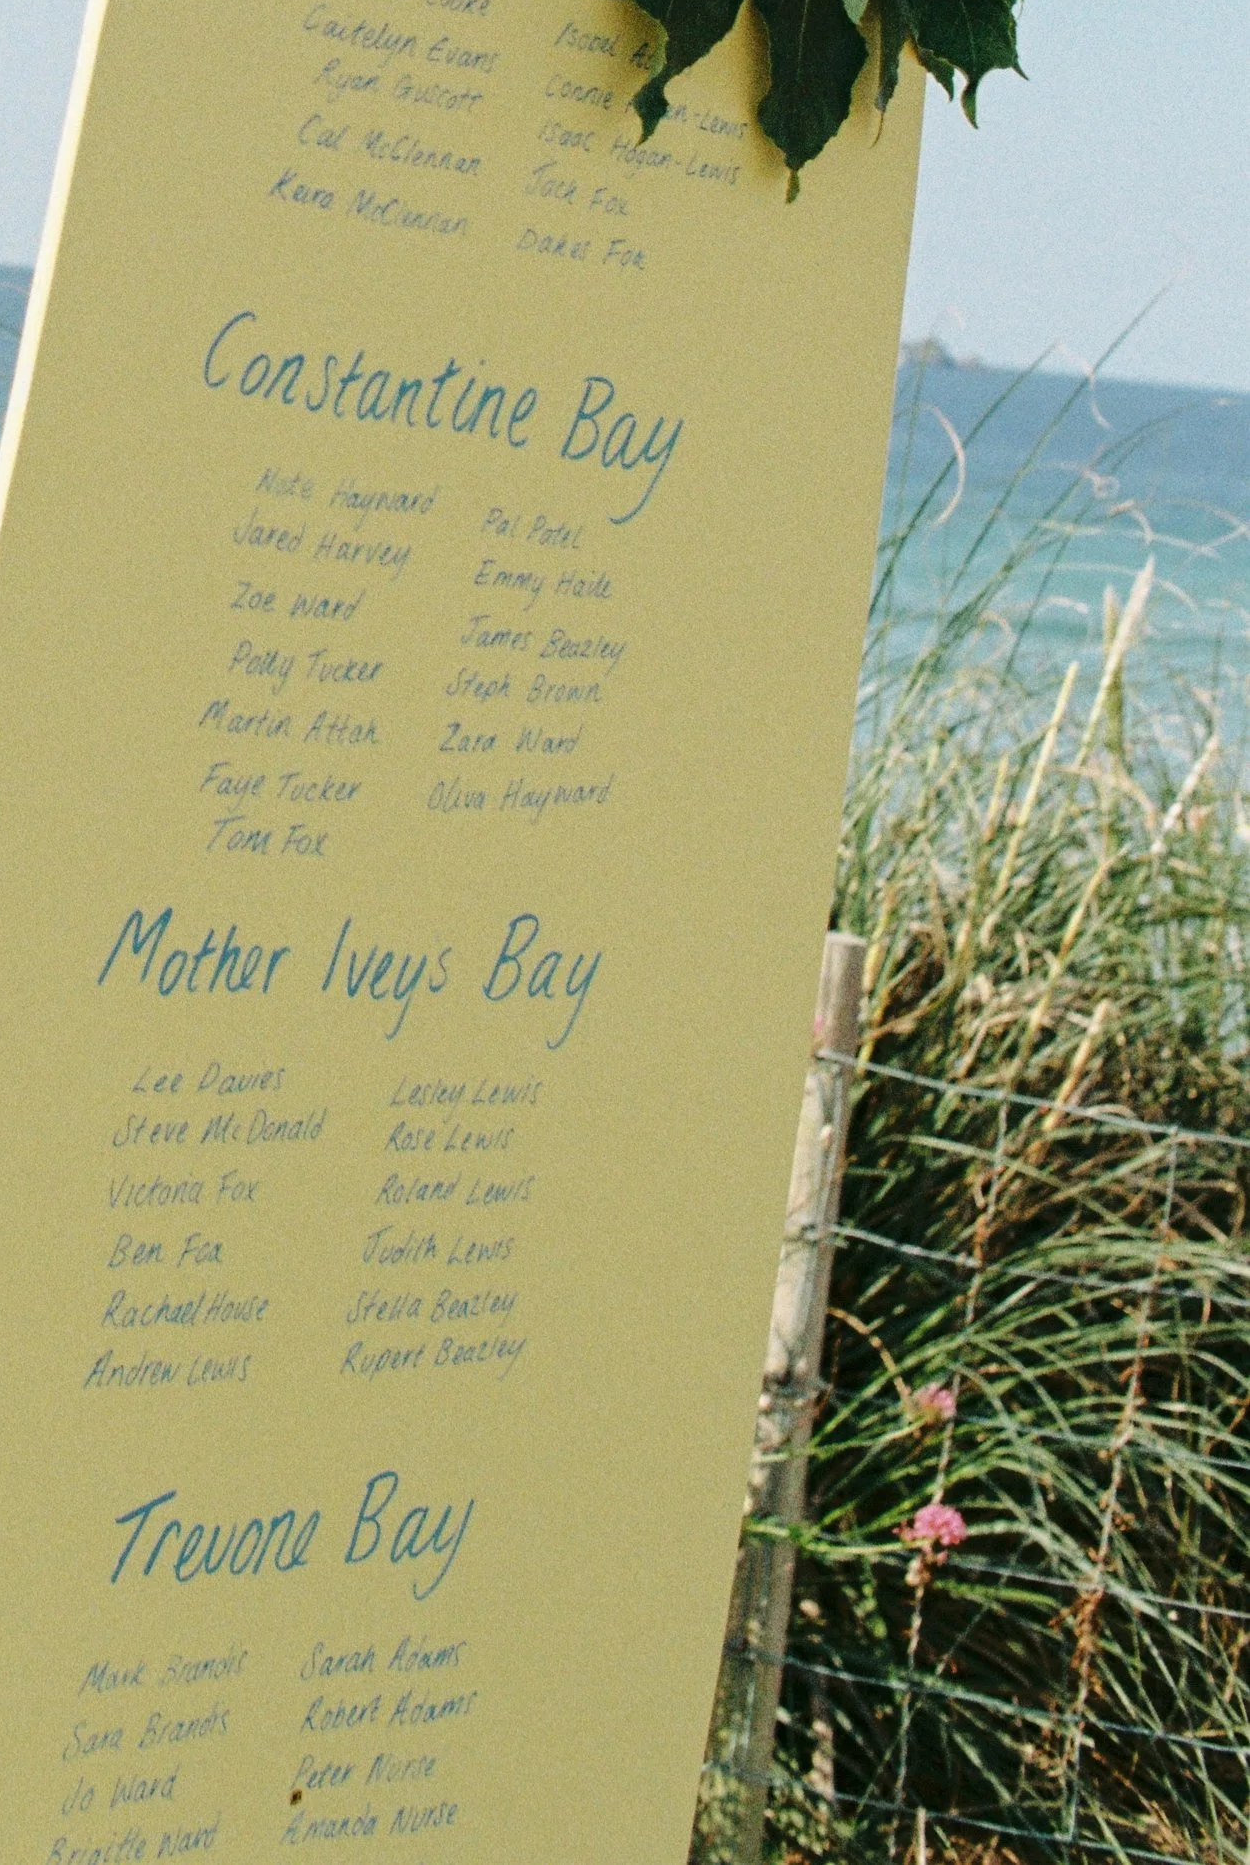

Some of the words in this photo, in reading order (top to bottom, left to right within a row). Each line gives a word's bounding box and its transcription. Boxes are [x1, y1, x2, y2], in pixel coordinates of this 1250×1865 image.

[427, 35, 501, 74] Evans
[313, 57, 380, 104] Ryan
[589, 186, 630, 217] Fox
[602, 238, 647, 272] Fox
[203, 309, 539, 449] Constantine
[559, 375, 686, 525] Bay
[313, 532, 413, 582] Harvey
[230, 580, 277, 613] Zoe
[473, 557, 546, 612] Emmy
[460, 613, 534, 651] James
[198, 697, 291, 738] Martin
[199, 760, 267, 814] Faye
[276, 771, 362, 802] Tucker
[205, 815, 273, 856] Tom
[281, 823, 330, 857] Fox
[97, 905, 293, 998] Mother
[482, 913, 603, 1051] Bay
[131, 1065, 184, 1094] Lee
[197, 1061, 286, 1096] Davies
[471, 1076, 544, 1107] Lewis
[112, 1113, 190, 1148] Steve
[385, 1120, 434, 1154] Rose
[443, 1123, 515, 1152] Lewis
[215, 1168, 261, 1204] Fox
[375, 1171, 462, 1207] Roland
[465, 1174, 536, 1207] Lewis
[107, 1232, 163, 1269] Ben
[447, 1235, 515, 1266] Lewis
[83, 1349, 180, 1391] Andrew
[187, 1353, 252, 1387] Lewis
[340, 1340, 426, 1382] Rupert
[110, 1489, 323, 1586] Trevone
[344, 1470, 476, 1602] Bay
[78, 1660, 147, 1697] Mark
[300, 1640, 376, 1682] Sarah
[387, 1634, 468, 1672] Adams
[300, 1694, 382, 1733] Robert
[386, 1689, 479, 1728] Adams
[61, 1718, 124, 1762] Sara
[61, 1776, 95, 1816] Jo
[109, 1762, 182, 1810] Ward
[289, 1754, 356, 1790] Peter
[279, 1802, 378, 1845] Amanda
[390, 1801, 458, 1835] Nurse
